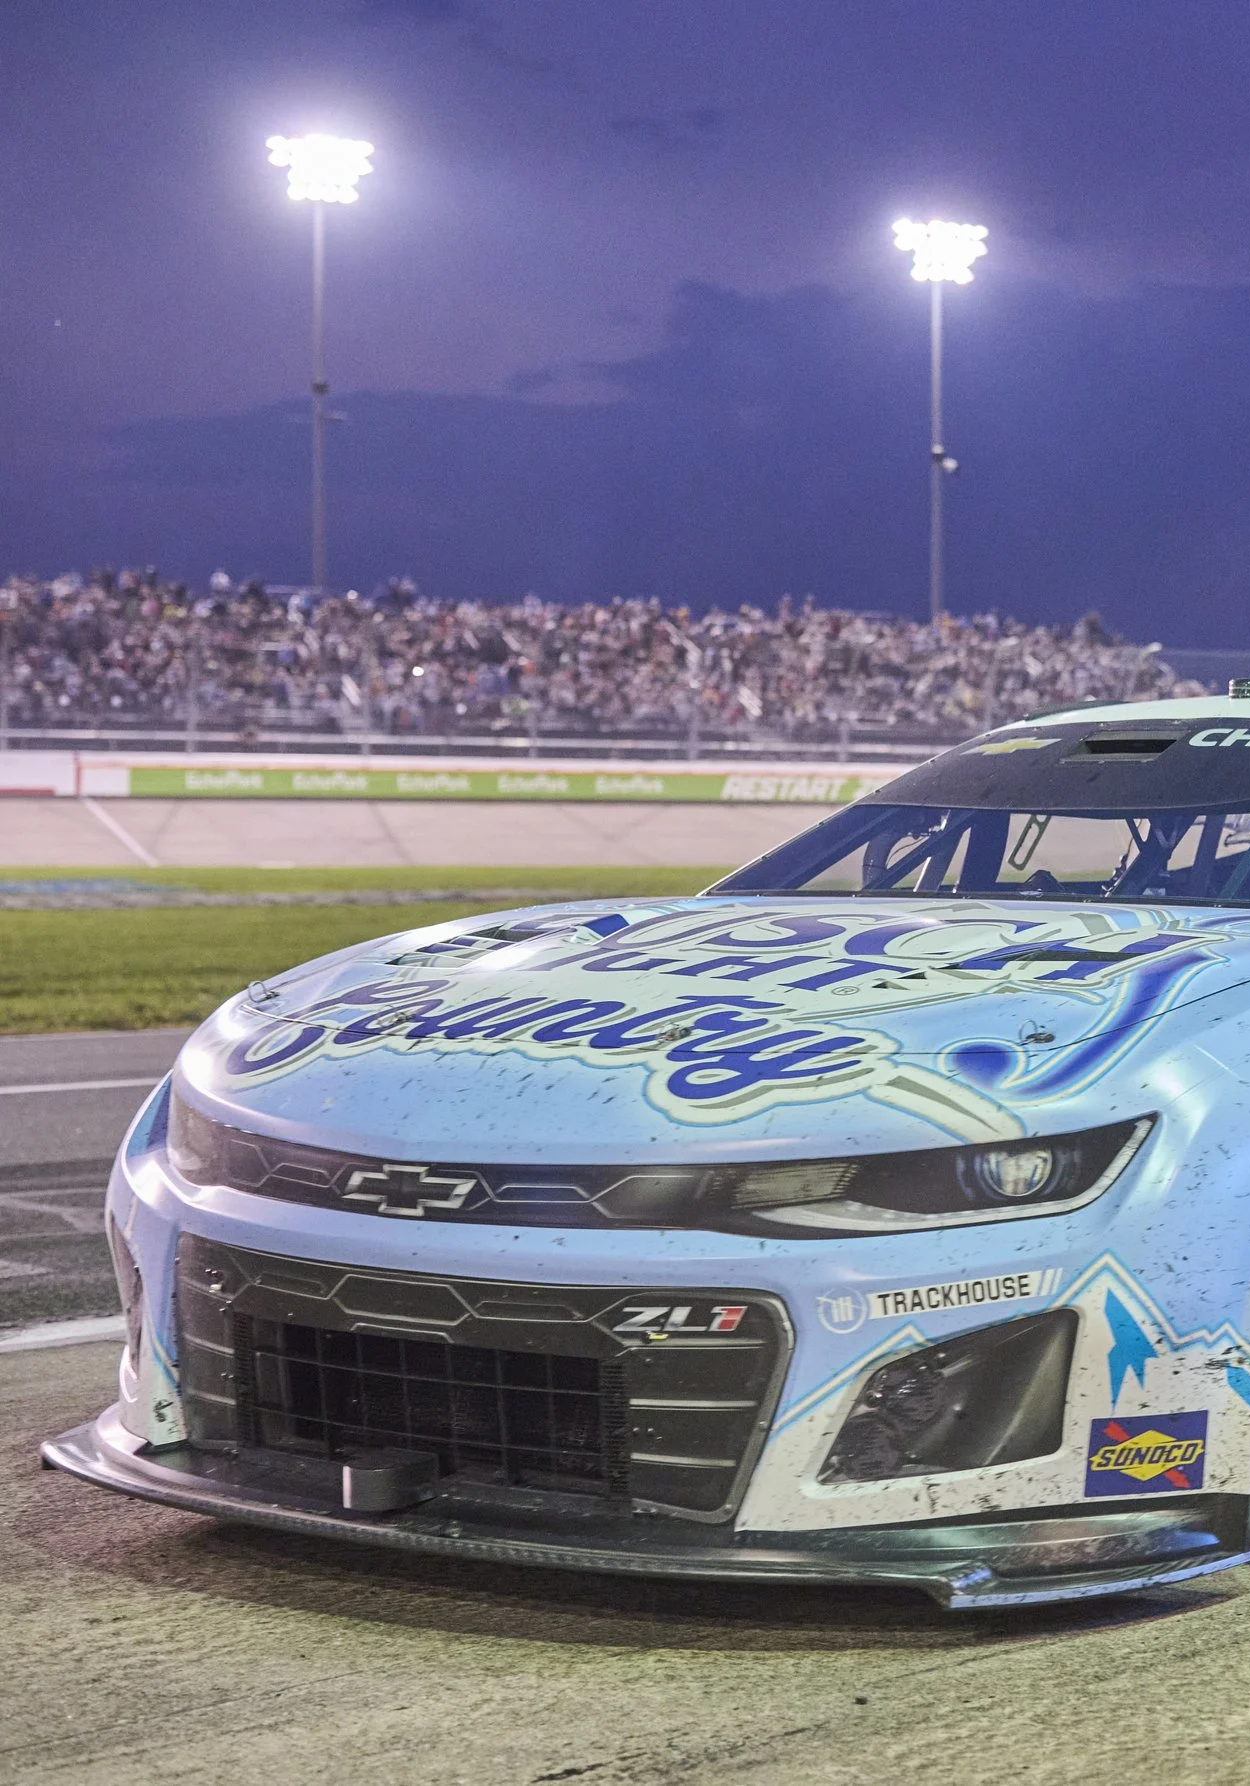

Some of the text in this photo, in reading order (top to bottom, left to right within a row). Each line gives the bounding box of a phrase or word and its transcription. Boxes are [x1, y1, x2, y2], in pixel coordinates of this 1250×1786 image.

[227, 979, 866, 1099] Country
[877, 1273, 1031, 1316] TRACKHOUSE
[612, 1306, 748, 1333] ZL1
[1096, 1442, 1199, 1468] SUNOCO
